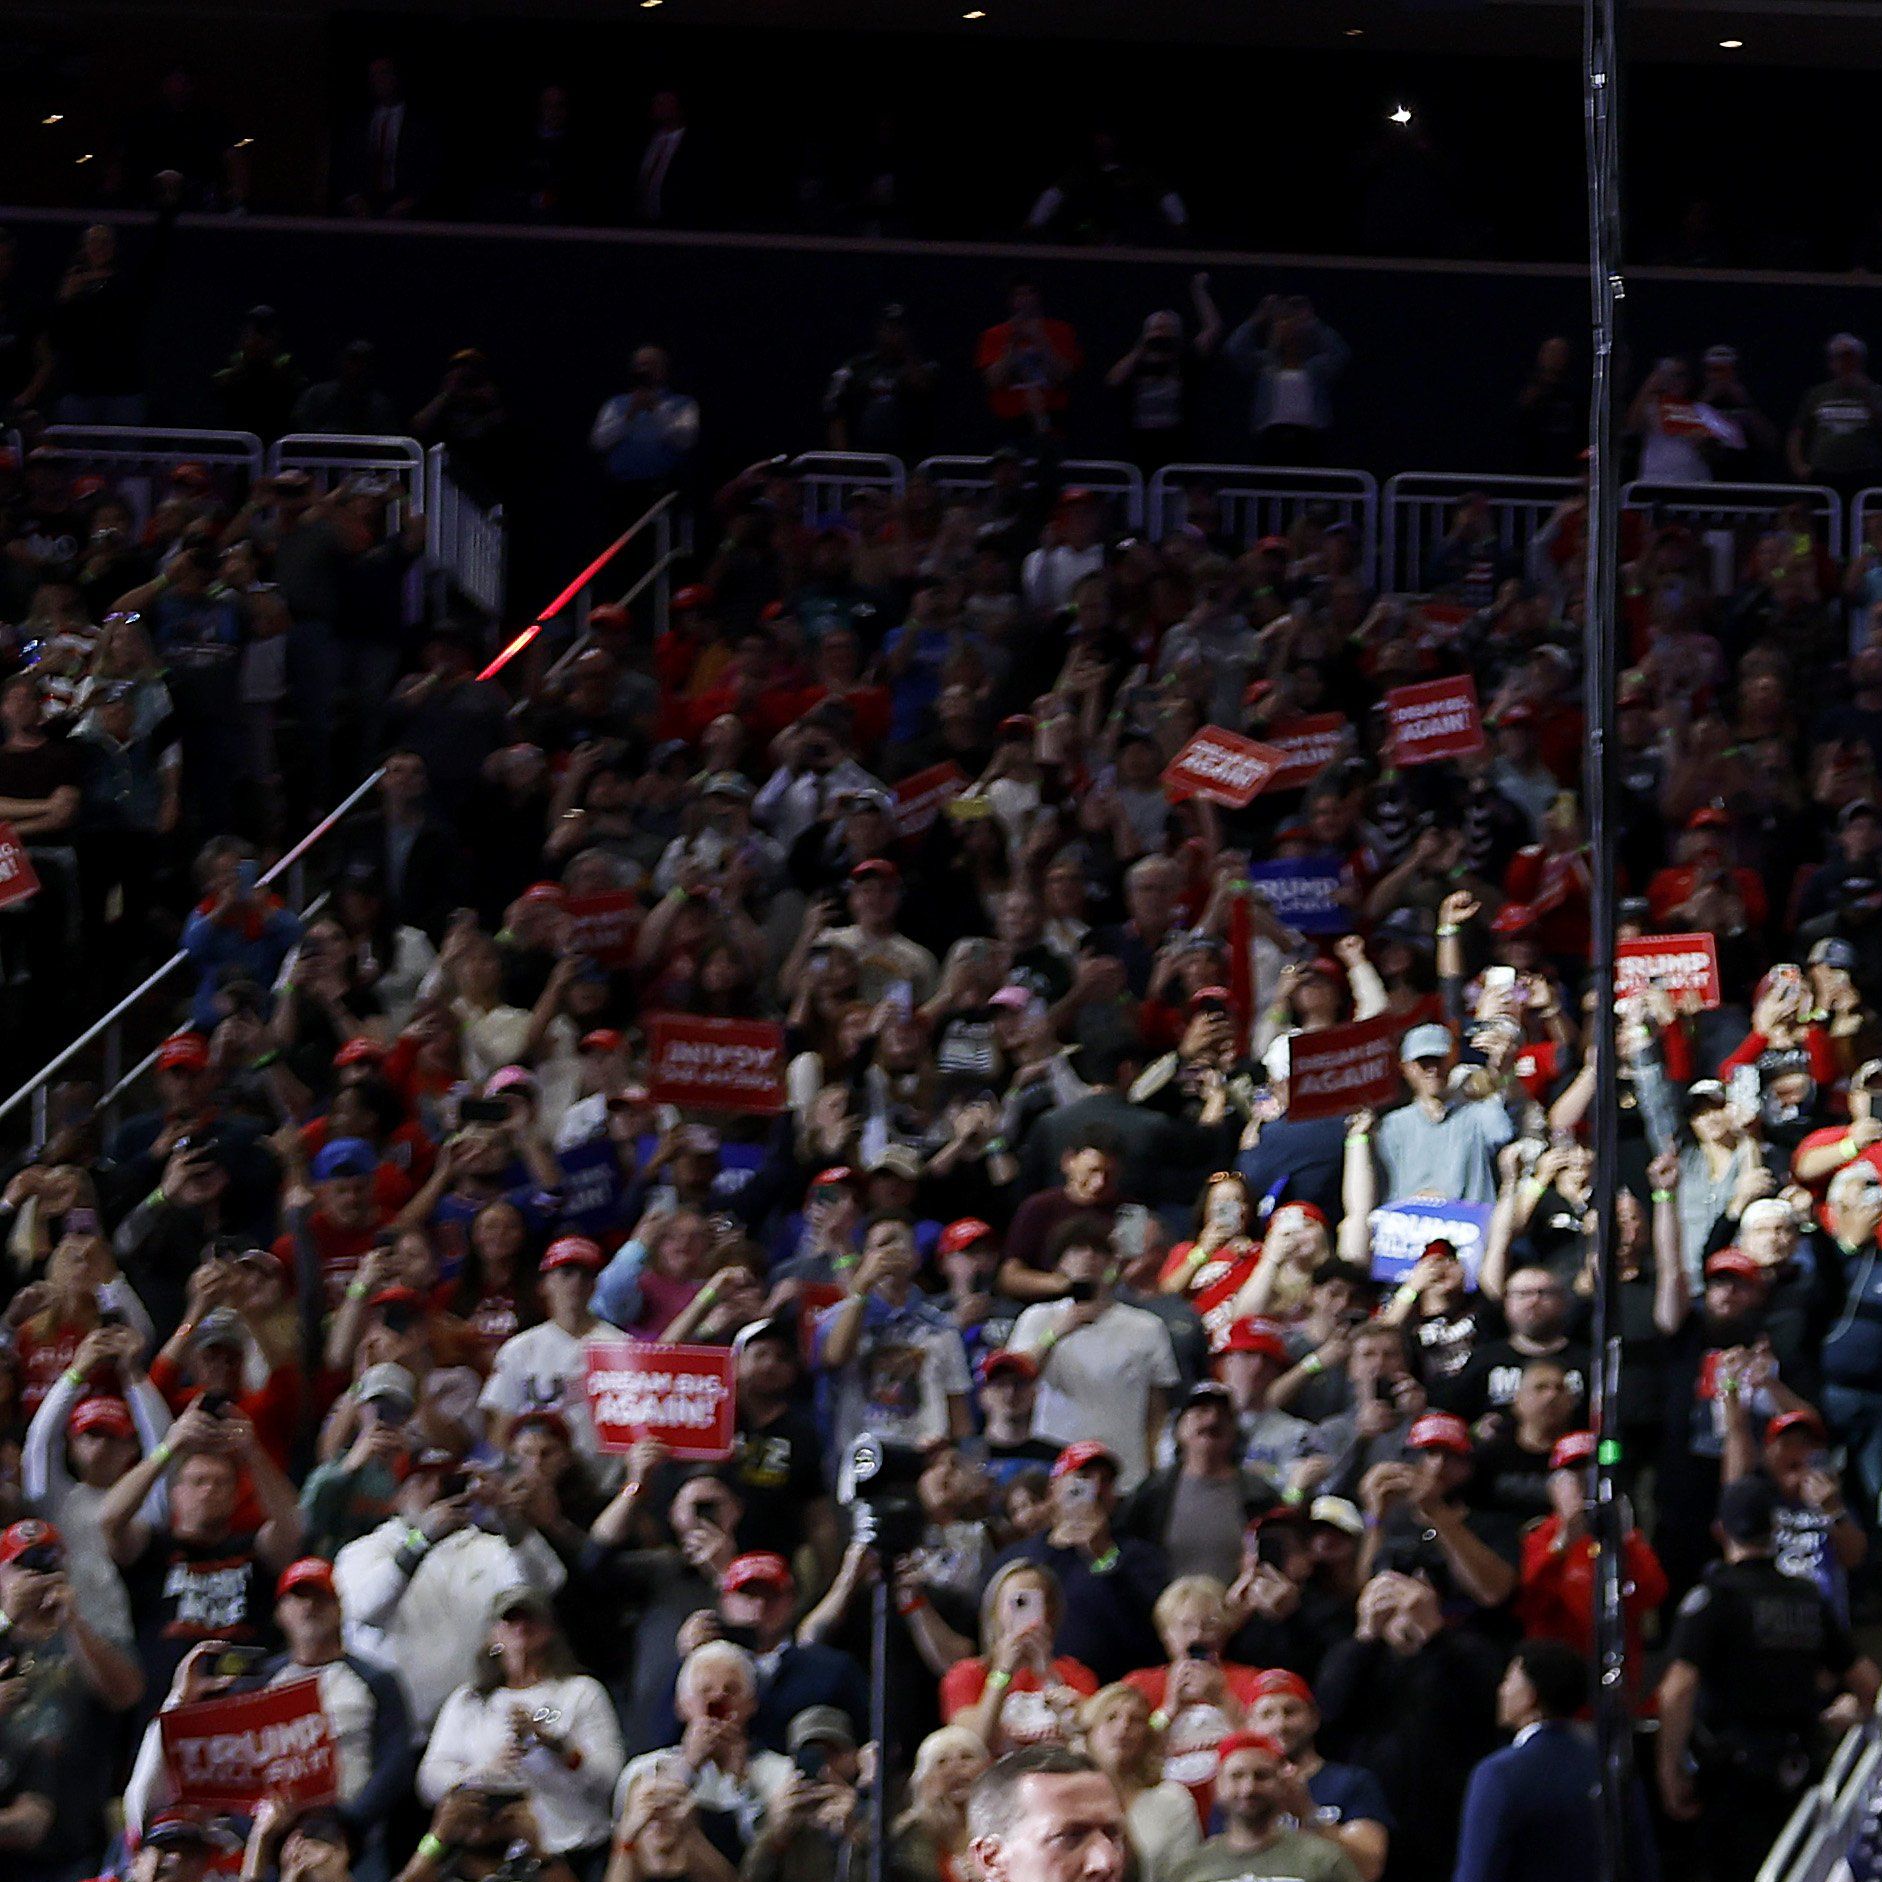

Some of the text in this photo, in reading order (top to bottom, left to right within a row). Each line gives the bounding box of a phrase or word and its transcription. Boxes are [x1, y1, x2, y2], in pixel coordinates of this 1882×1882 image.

[588, 1370, 673, 1396] DREAM
[593, 1393, 717, 1430] AGAIN!
[173, 1712, 328, 1776] TRUMP
